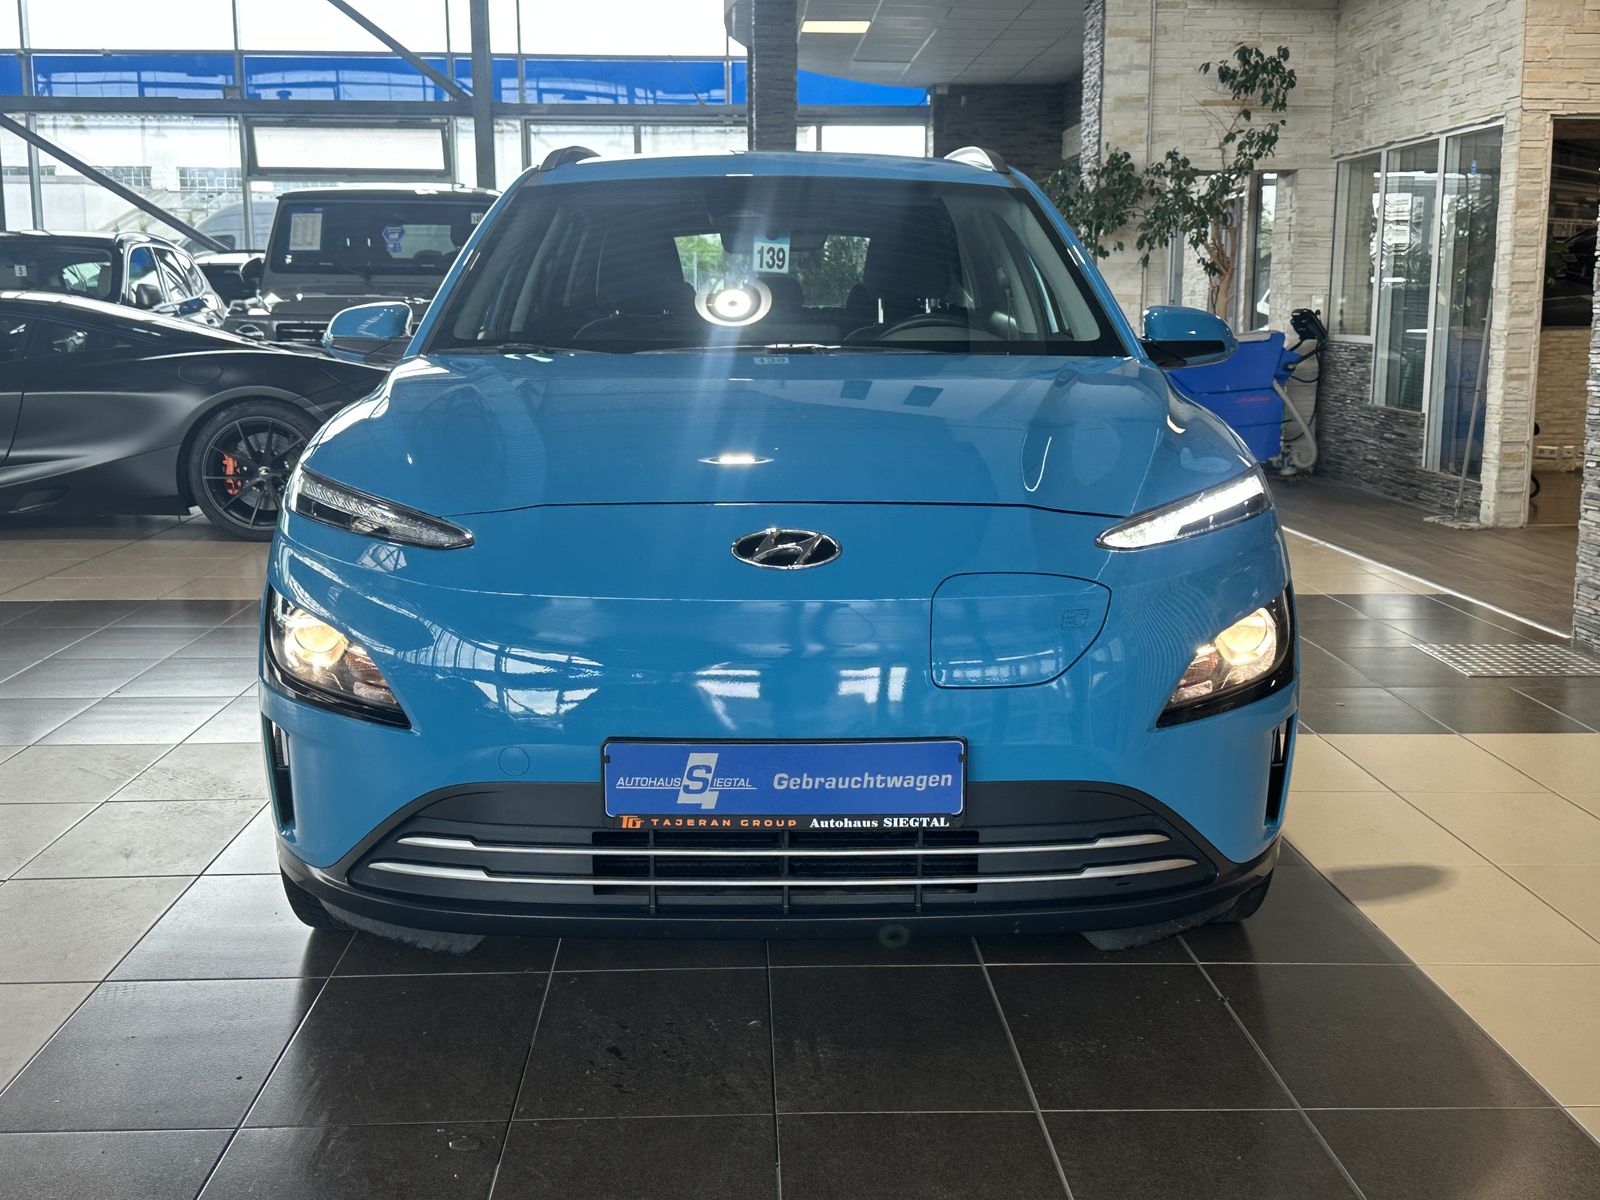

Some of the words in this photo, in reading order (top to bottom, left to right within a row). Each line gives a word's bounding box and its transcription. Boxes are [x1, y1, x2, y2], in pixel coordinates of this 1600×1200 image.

[757, 245, 786, 270] 139
[616, 777, 682, 788] AUTOHAUS
[773, 772, 953, 791] Gebrauchtwagen
[651, 818, 731, 827] TAJERAN
[740, 818, 797, 827] GROUP
[809, 818, 878, 828] Autohaus
[883, 817, 950, 828] SIEGTAL
